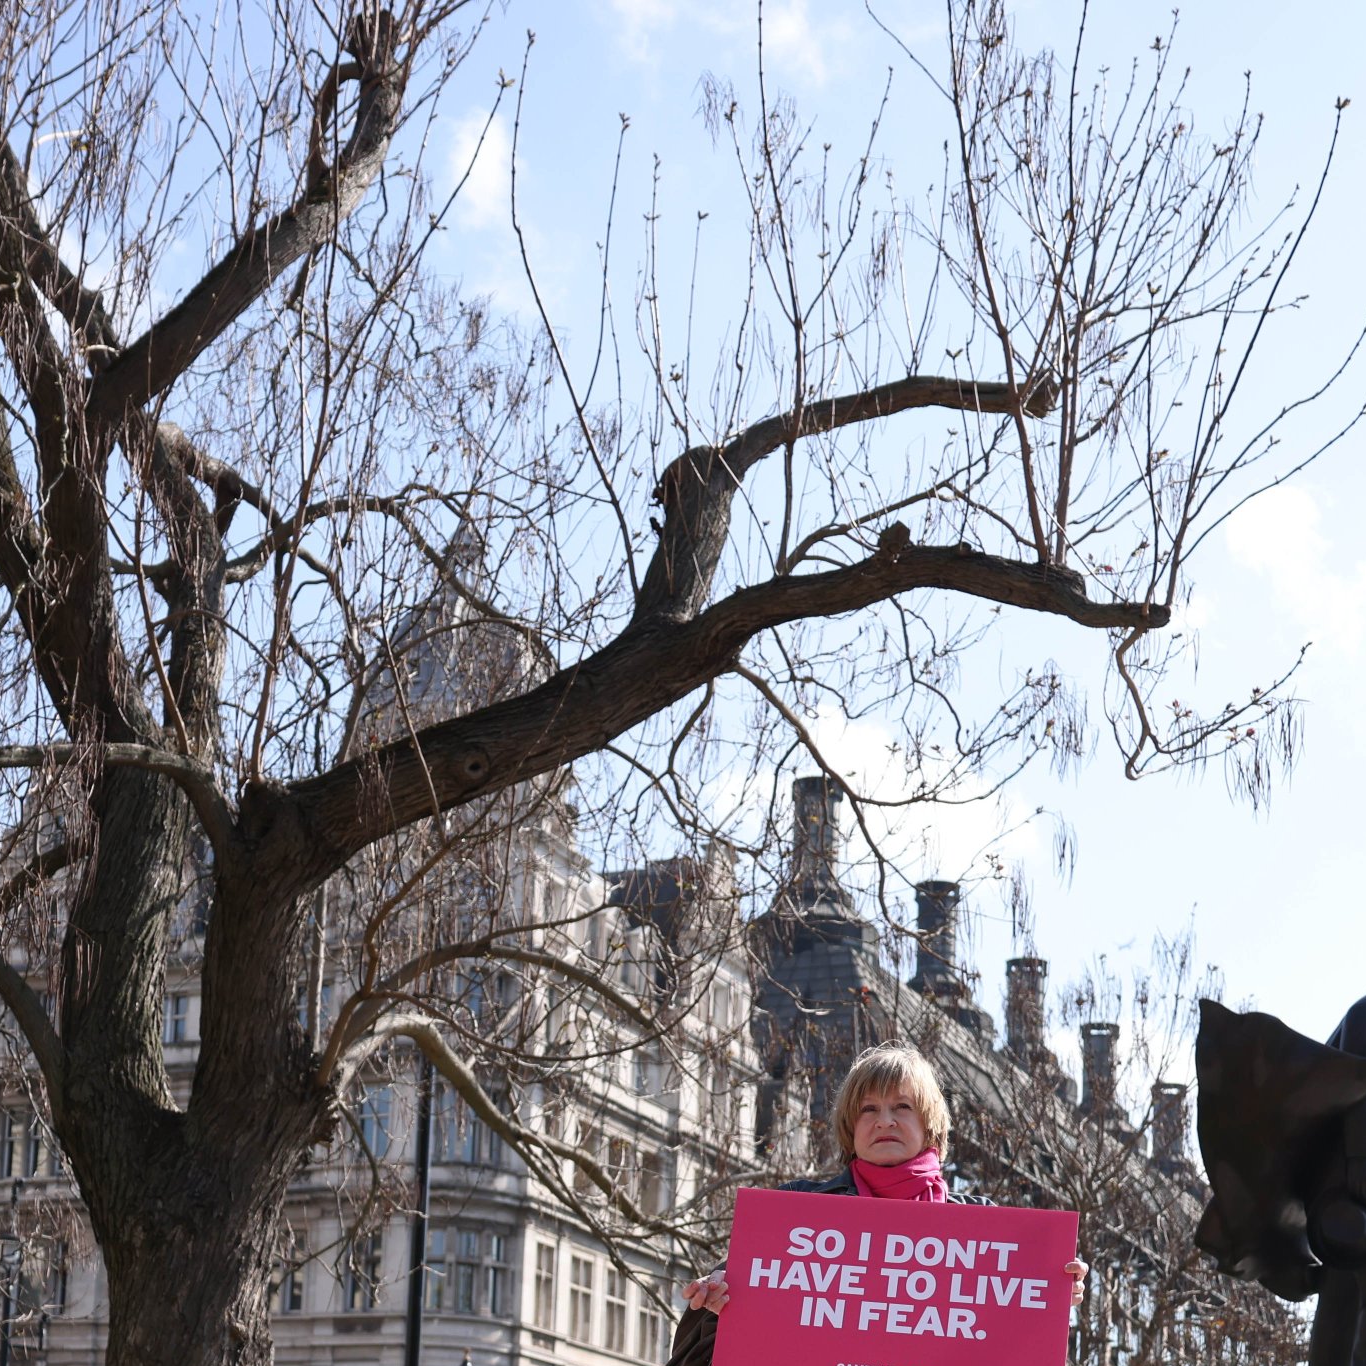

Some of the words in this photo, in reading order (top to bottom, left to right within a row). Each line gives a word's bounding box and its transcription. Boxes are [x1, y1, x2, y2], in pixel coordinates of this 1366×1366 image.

[787, 1227, 845, 1258] SO
[859, 1232, 871, 1261] I
[885, 1234, 1018, 1271] DON'T
[749, 1258, 867, 1295] HAVE
[881, 1268, 936, 1300] TO
[950, 1274, 1048, 1309] LIVE
[800, 1297, 845, 1329] IN
[858, 1301, 987, 1340] FEAR.
